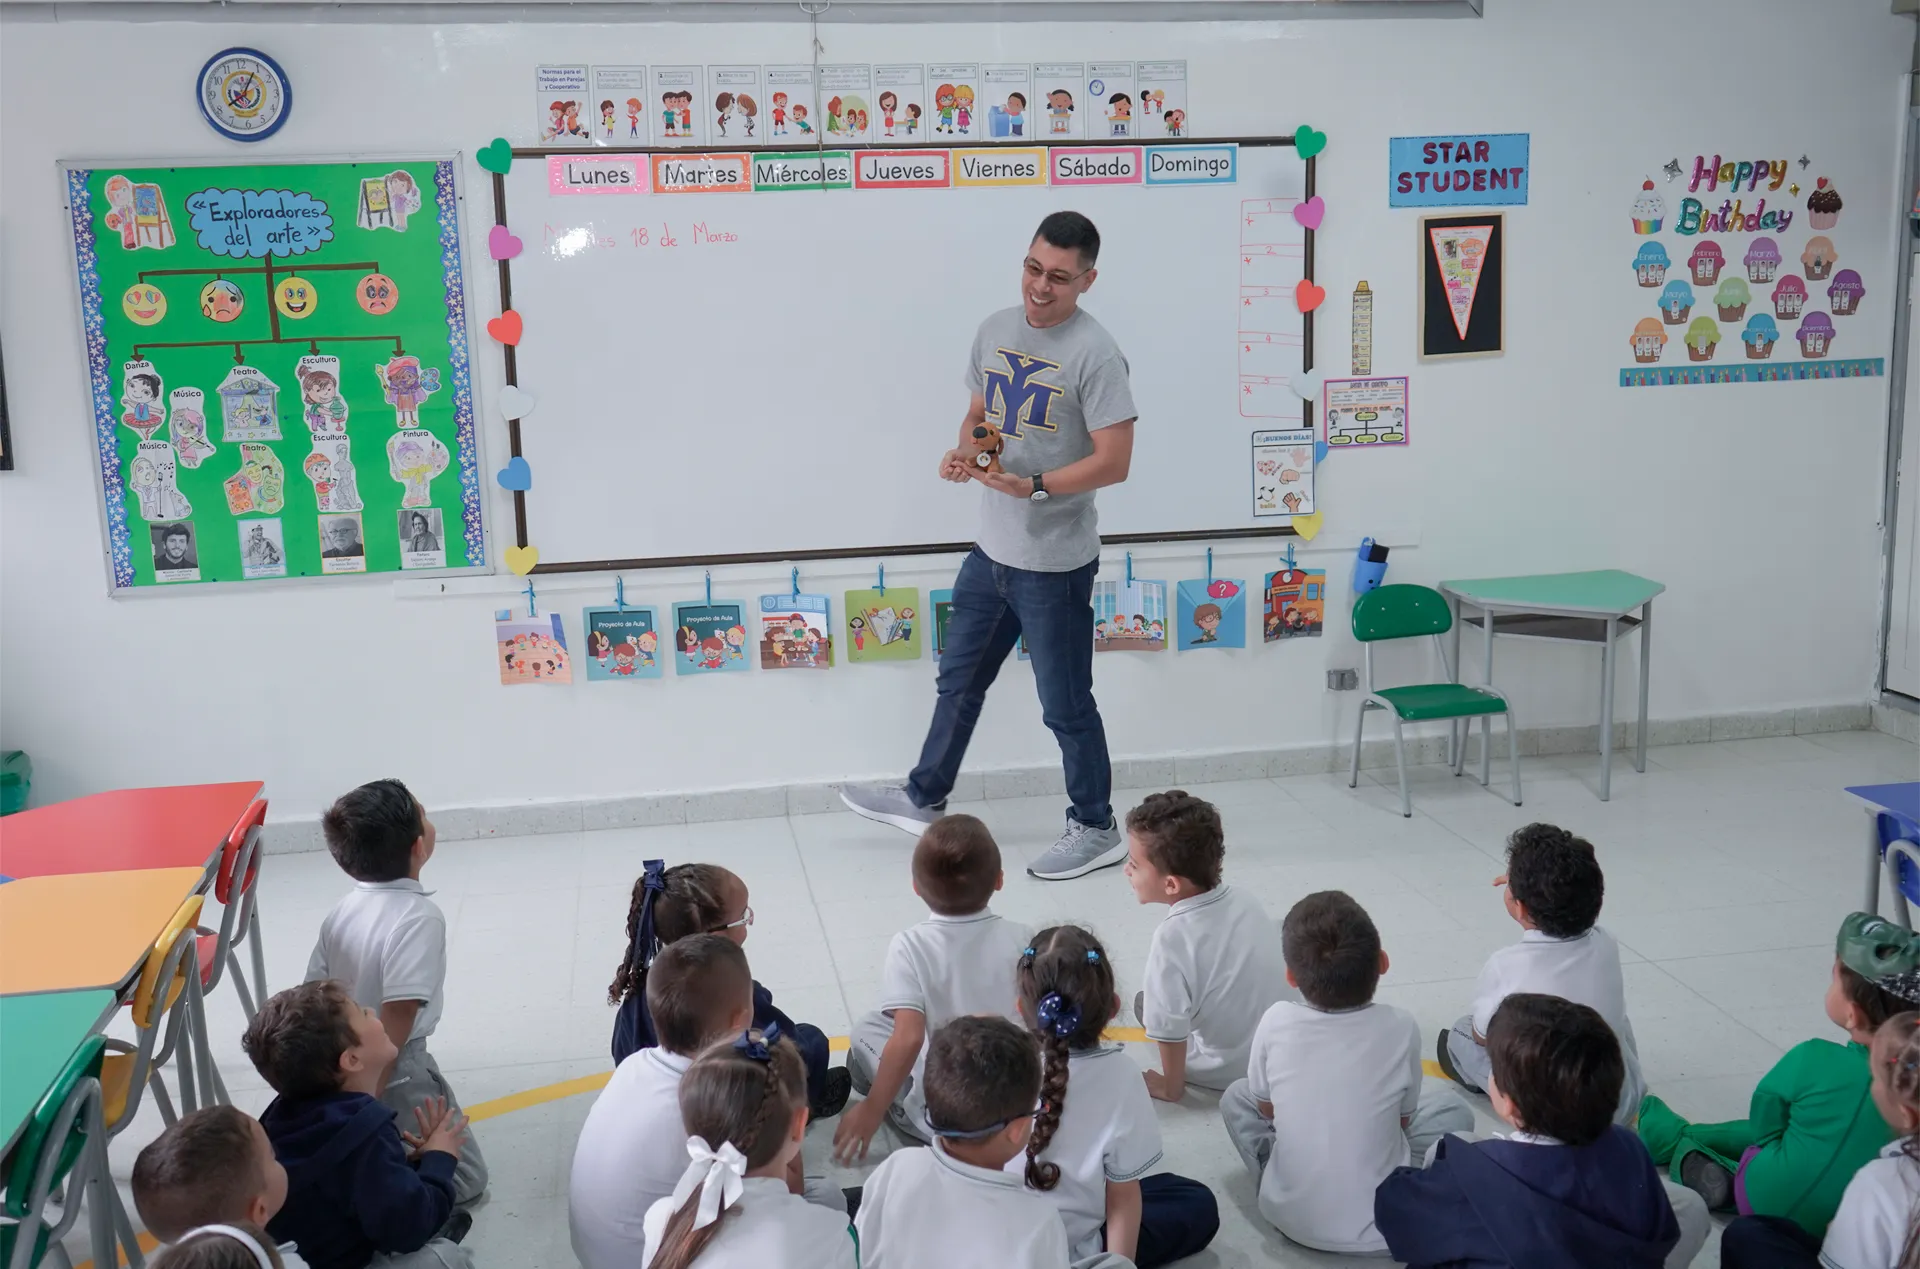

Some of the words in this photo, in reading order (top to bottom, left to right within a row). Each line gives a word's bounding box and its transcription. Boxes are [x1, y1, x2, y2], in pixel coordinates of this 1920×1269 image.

[236, 60, 246, 69] 12
[256, 64, 260, 73] 1
[223, 65, 230, 74] 11
[214, 76, 222, 85] 10
[266, 74, 271, 83] 2
[210, 90, 216, 99] 9
[274, 90, 279, 98] 3
[217, 106, 223, 114] 8
[270, 104, 275, 112] 4
[229, 116, 234, 126] 7
[260, 114, 265, 124] 5
[246, 120, 251, 128] 6
[1423, 140, 1490, 164] STAR
[865, 158, 935, 180] Jueves
[962, 158, 1036, 178] Viernes
[1059, 156, 1132, 176] Sábado
[1151, 154, 1230, 177] Domingo
[568, 164, 630, 184] Lunes
[665, 164, 738, 185] Martes
[757, 162, 848, 184] Miércoles
[1688, 154, 1788, 193] Happy
[1397, 168, 1524, 194] STUDENT
[1674, 197, 1793, 236] Birthday
[224, 224, 252, 246] del
[630, 227, 650, 248] 18
[660, 222, 678, 247] de
[692, 221, 739, 244] Marzo
[1266, 246, 1276, 254] 2
[1264, 288, 1269, 296] 3
[302, 356, 336, 364] Escultura
[125, 362, 150, 370] Danza
[173, 390, 201, 399] Música
[314, 434, 347, 442] Escultura
[139, 442, 168, 450] Música
